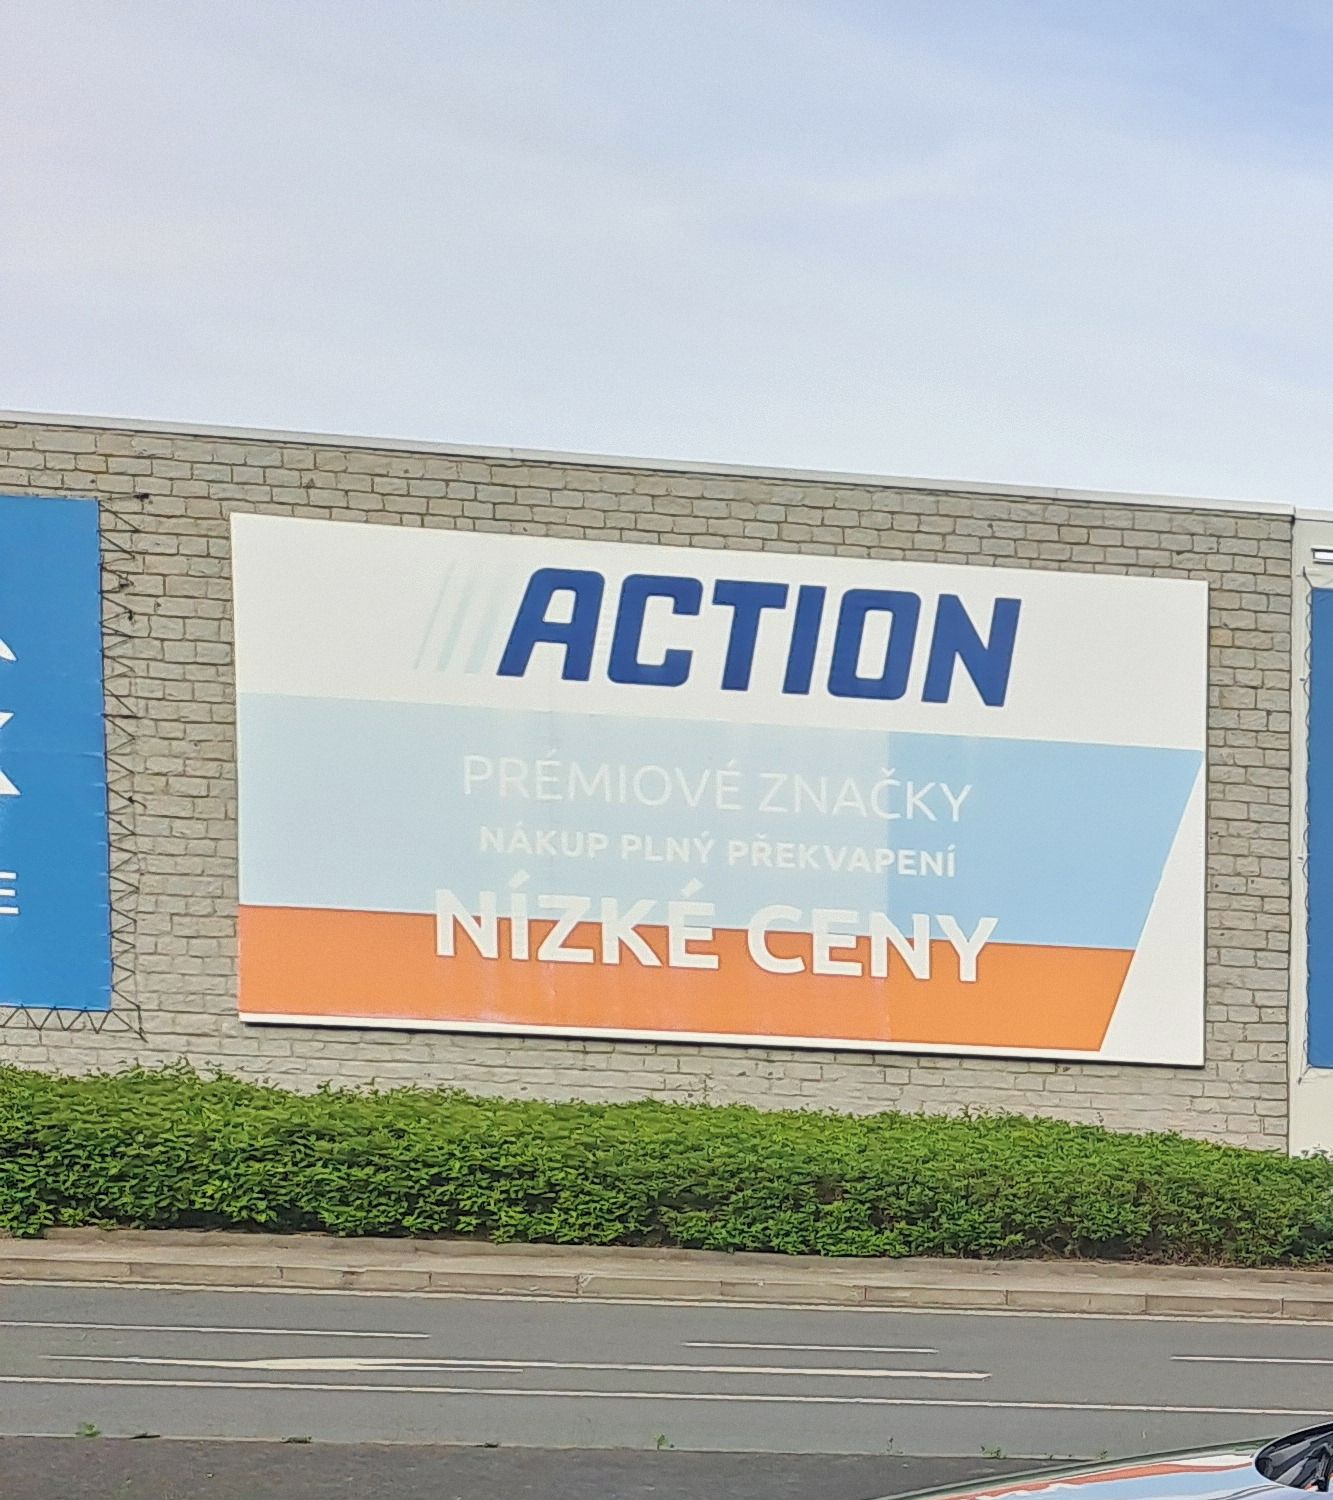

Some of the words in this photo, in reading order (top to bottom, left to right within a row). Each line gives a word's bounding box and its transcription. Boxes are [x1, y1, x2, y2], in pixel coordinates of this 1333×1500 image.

[495, 567, 1022, 707] ACTION
[462, 748, 744, 811] PRÉMIOVÉ
[758, 766, 973, 823] ZNAČKY
[479, 820, 609, 859] NÁKUP
[620, 831, 716, 865] PLNÝ
[727, 833, 957, 878] PŘEKVAPENÍ
[434, 868, 720, 971] NÍZKÉ
[746, 903, 999, 983] CENY
